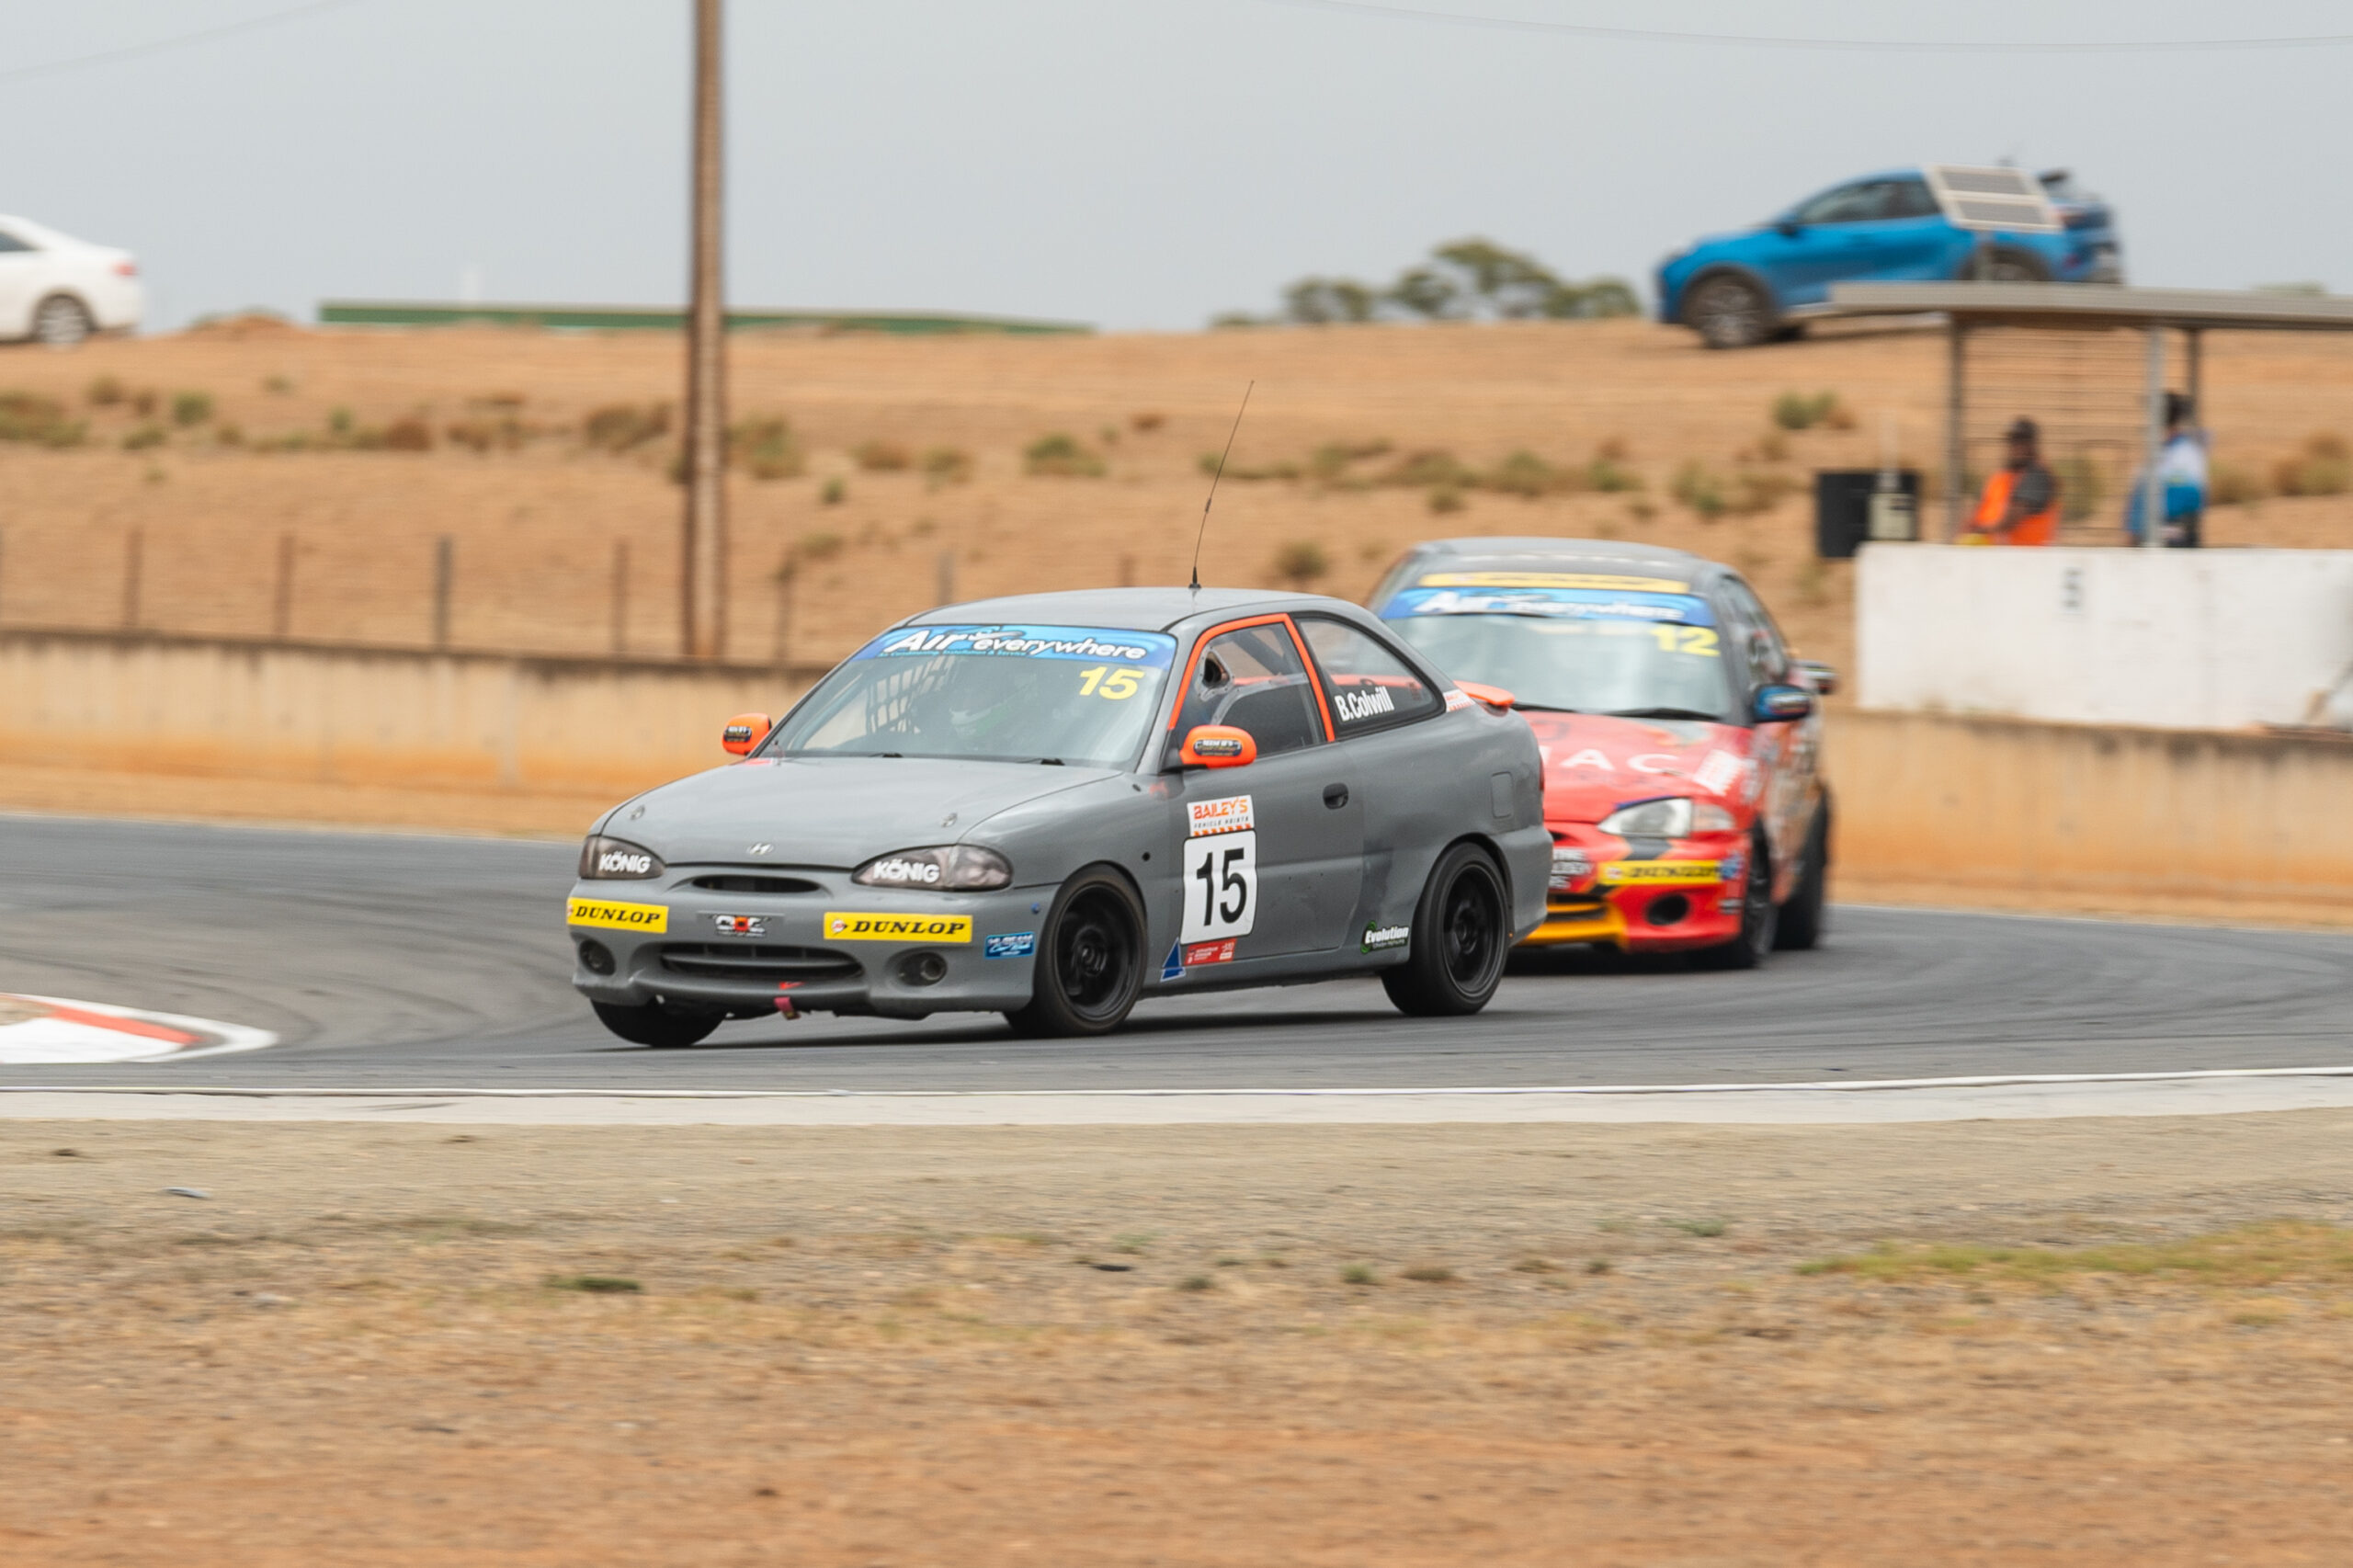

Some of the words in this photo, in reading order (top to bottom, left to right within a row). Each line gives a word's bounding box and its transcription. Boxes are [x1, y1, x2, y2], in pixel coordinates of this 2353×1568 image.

[883, 629, 968, 652] Air
[972, 636, 1147, 660] everywhere
[1651, 627, 1721, 656] 12
[1078, 666, 1145, 700] 15
[1335, 686, 1394, 722] B.Colwill
[1194, 797, 1248, 820] BAILEY'S
[598, 851, 652, 873] KÖNIG
[873, 858, 940, 883] KÖNIG
[1196, 847, 1247, 926] 15
[575, 906, 661, 925] DUNLOP
[852, 920, 965, 935] DUNLOP
[1365, 926, 1409, 944] Evolution
